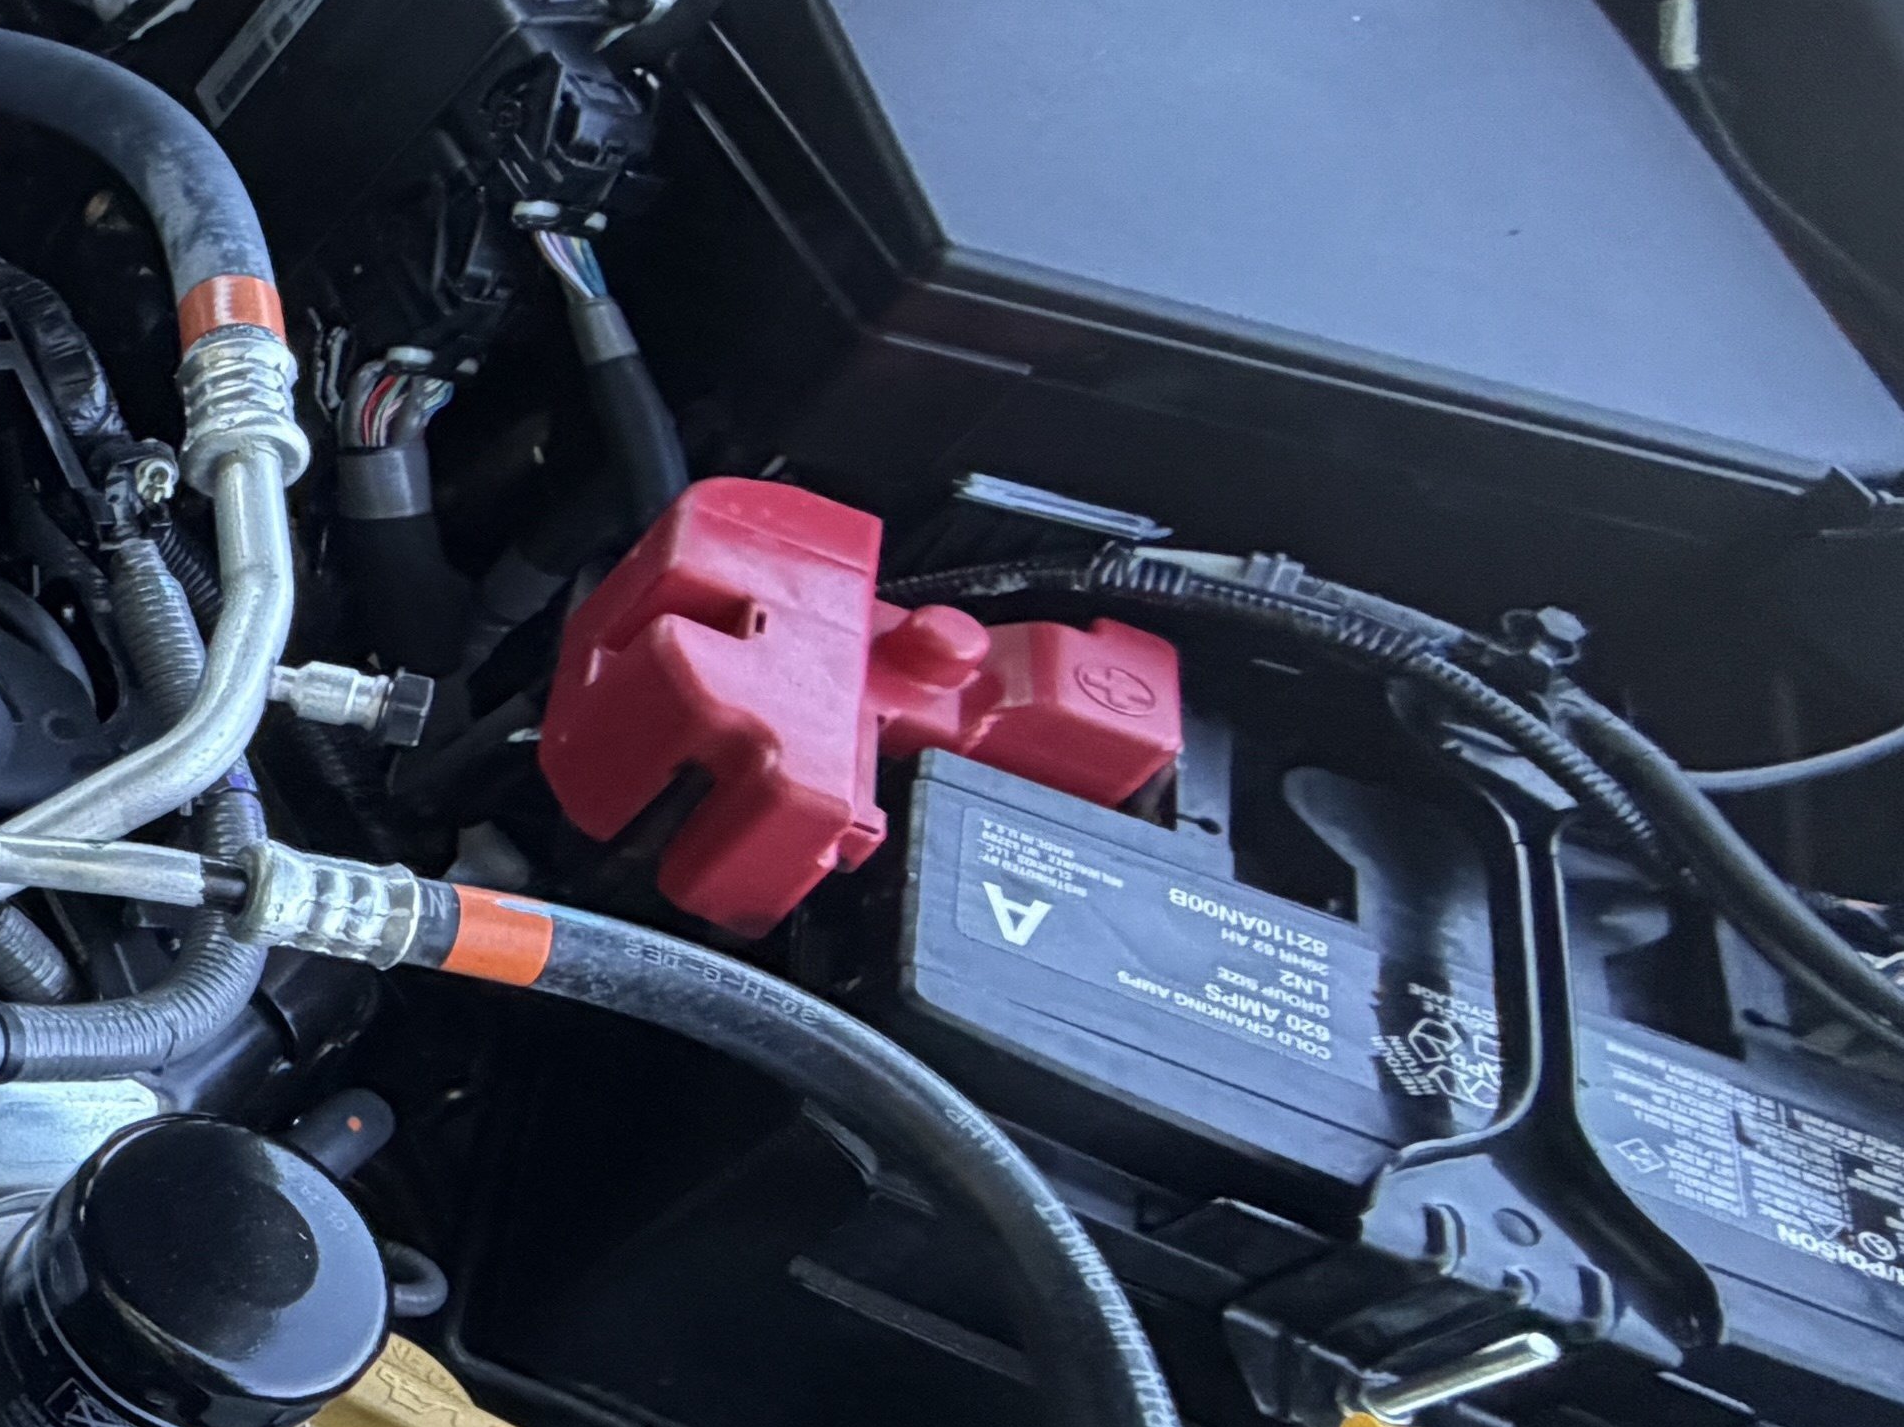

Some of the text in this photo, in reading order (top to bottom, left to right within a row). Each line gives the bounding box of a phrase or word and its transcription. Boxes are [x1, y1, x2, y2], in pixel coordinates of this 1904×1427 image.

[1169, 887, 1329, 957] 82110AN00B
[1204, 983, 1331, 1042] 620 AMPS
[1217, 966, 1330, 1018] GROUP SIZE
[1279, 969, 1329, 1001] LN2
[1117, 970, 1332, 1060] COLD CRANKING AMPS
